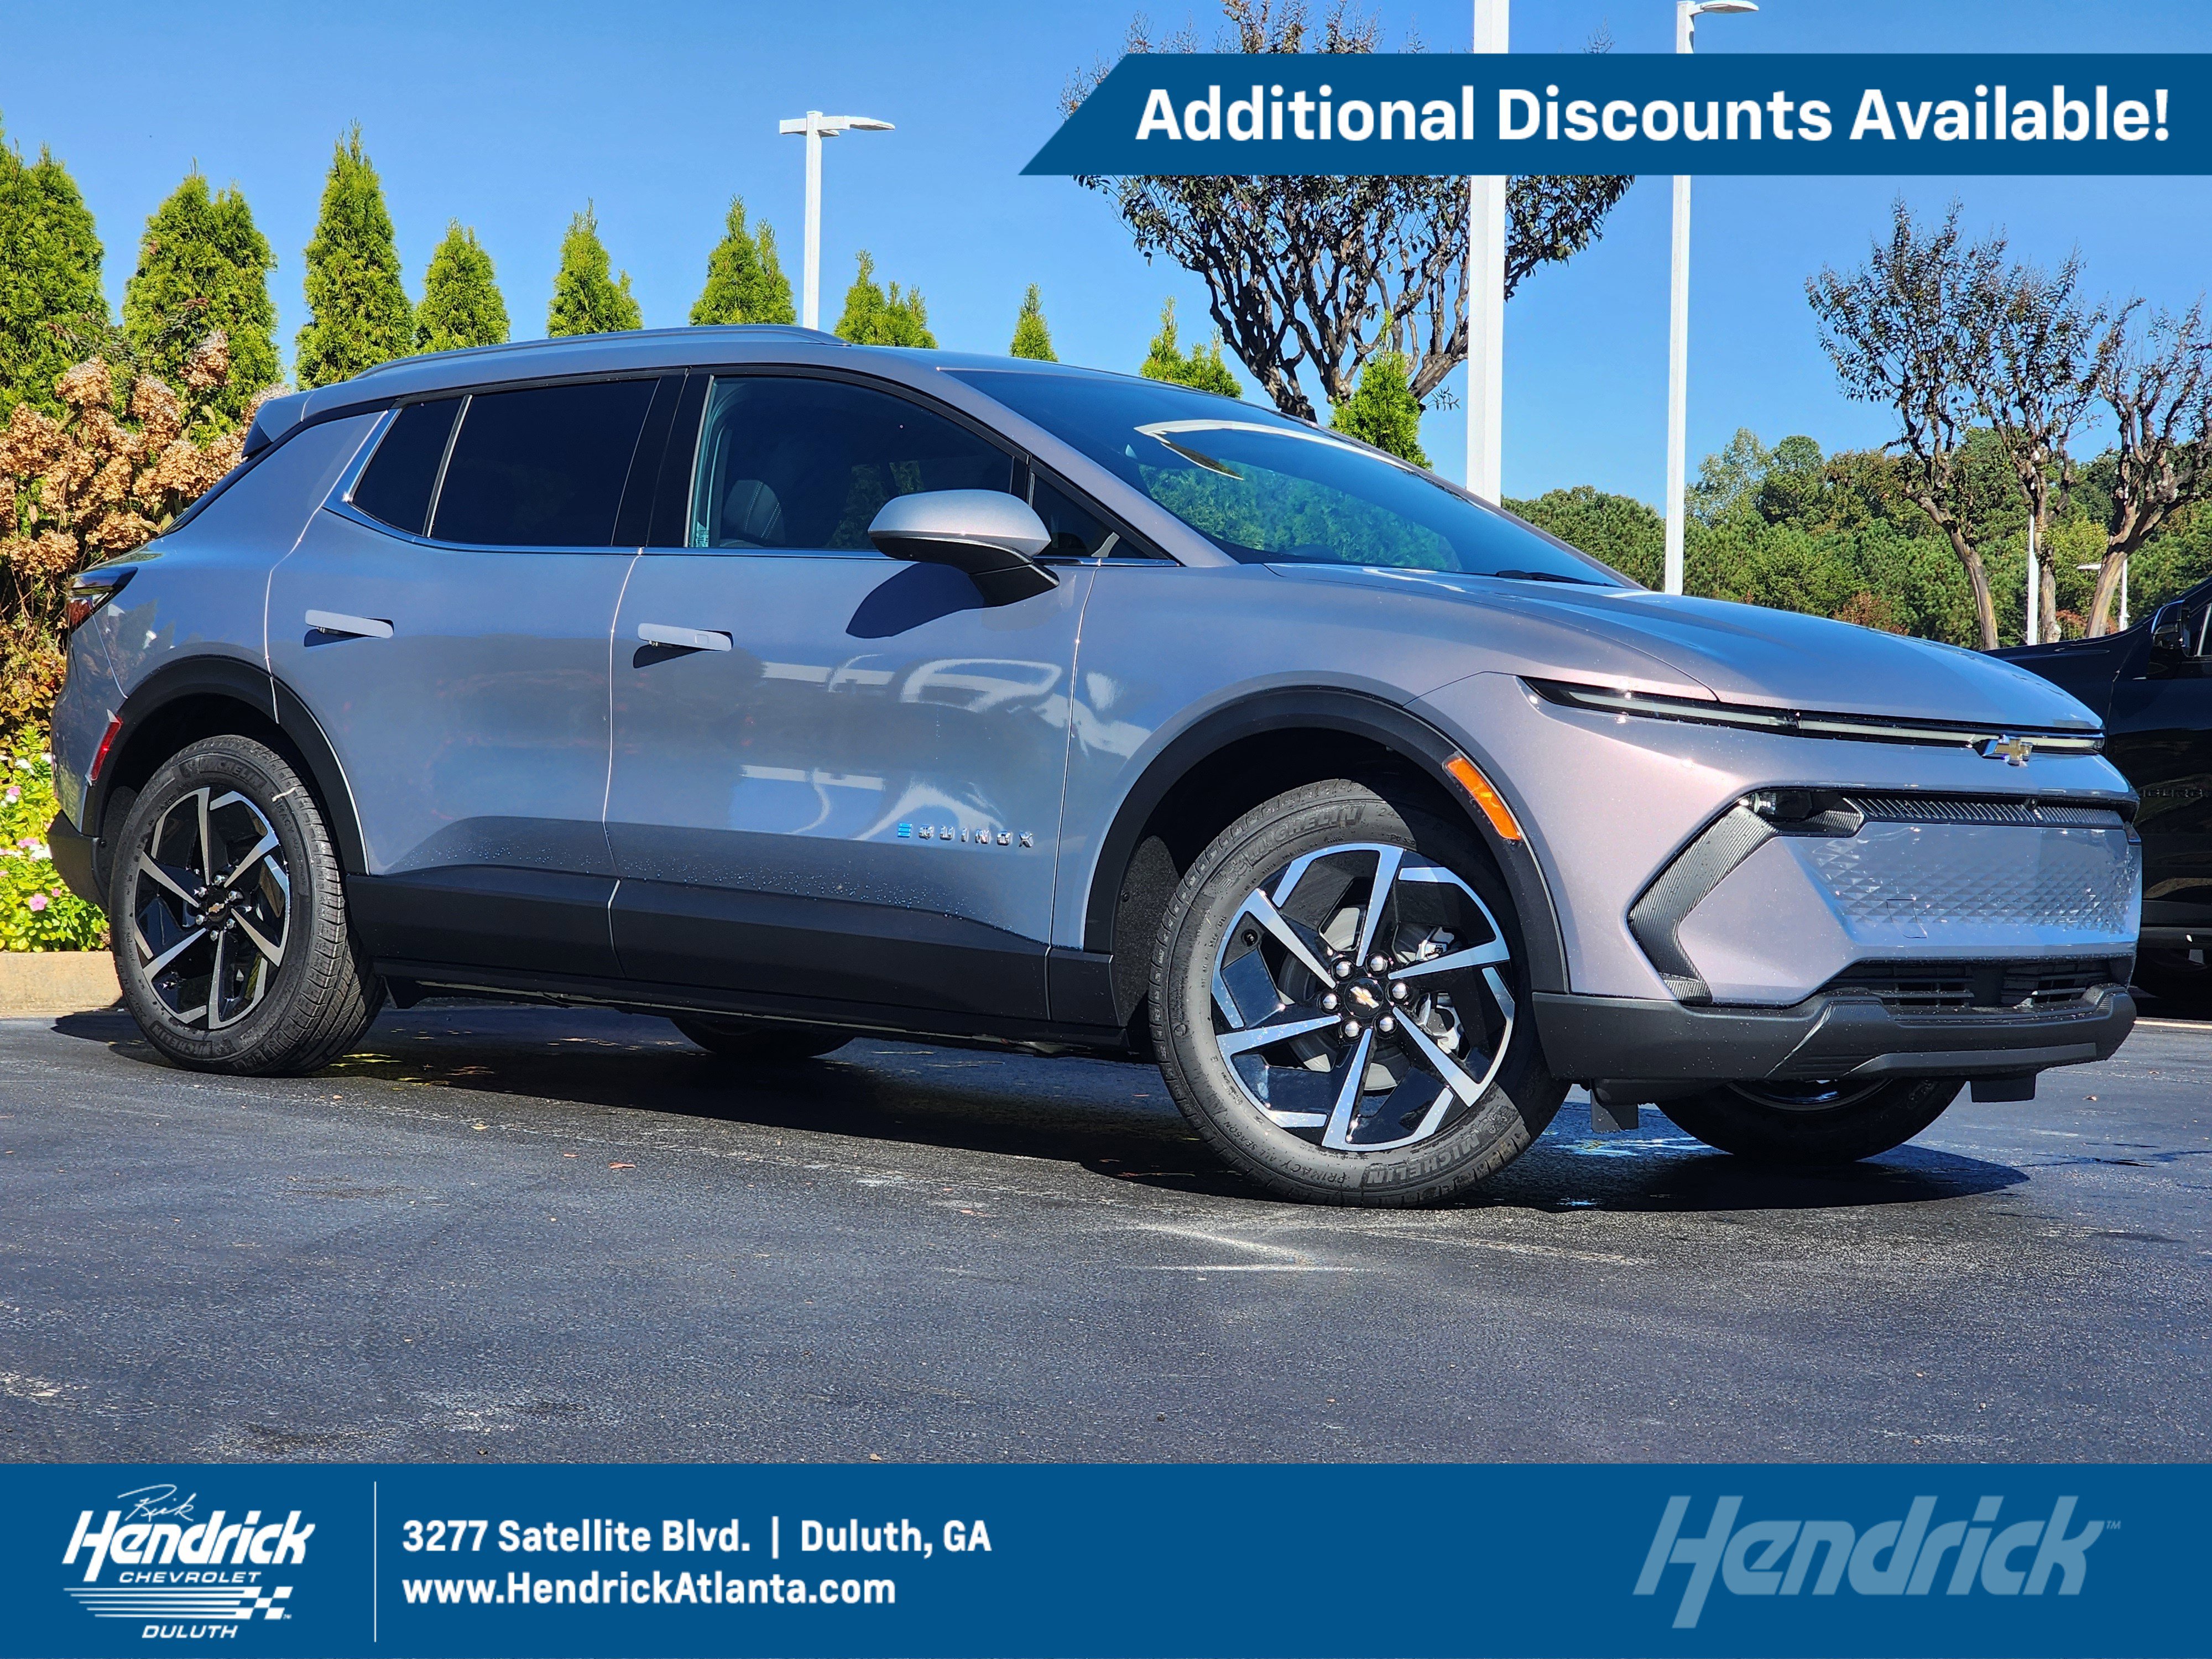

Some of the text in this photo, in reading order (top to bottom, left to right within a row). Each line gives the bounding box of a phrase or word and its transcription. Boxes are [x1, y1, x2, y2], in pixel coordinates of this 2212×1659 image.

[897, 822, 1034, 848] EQUINOX
[1246, 804, 1365, 862] MICHELIN
[1223, 1120, 1258, 1150] SEASON
[1259, 1149, 1277, 1162] ALL
[1367, 1135, 1480, 1184] MICHELIN
[1280, 1159, 1348, 1185] PRIMACY
